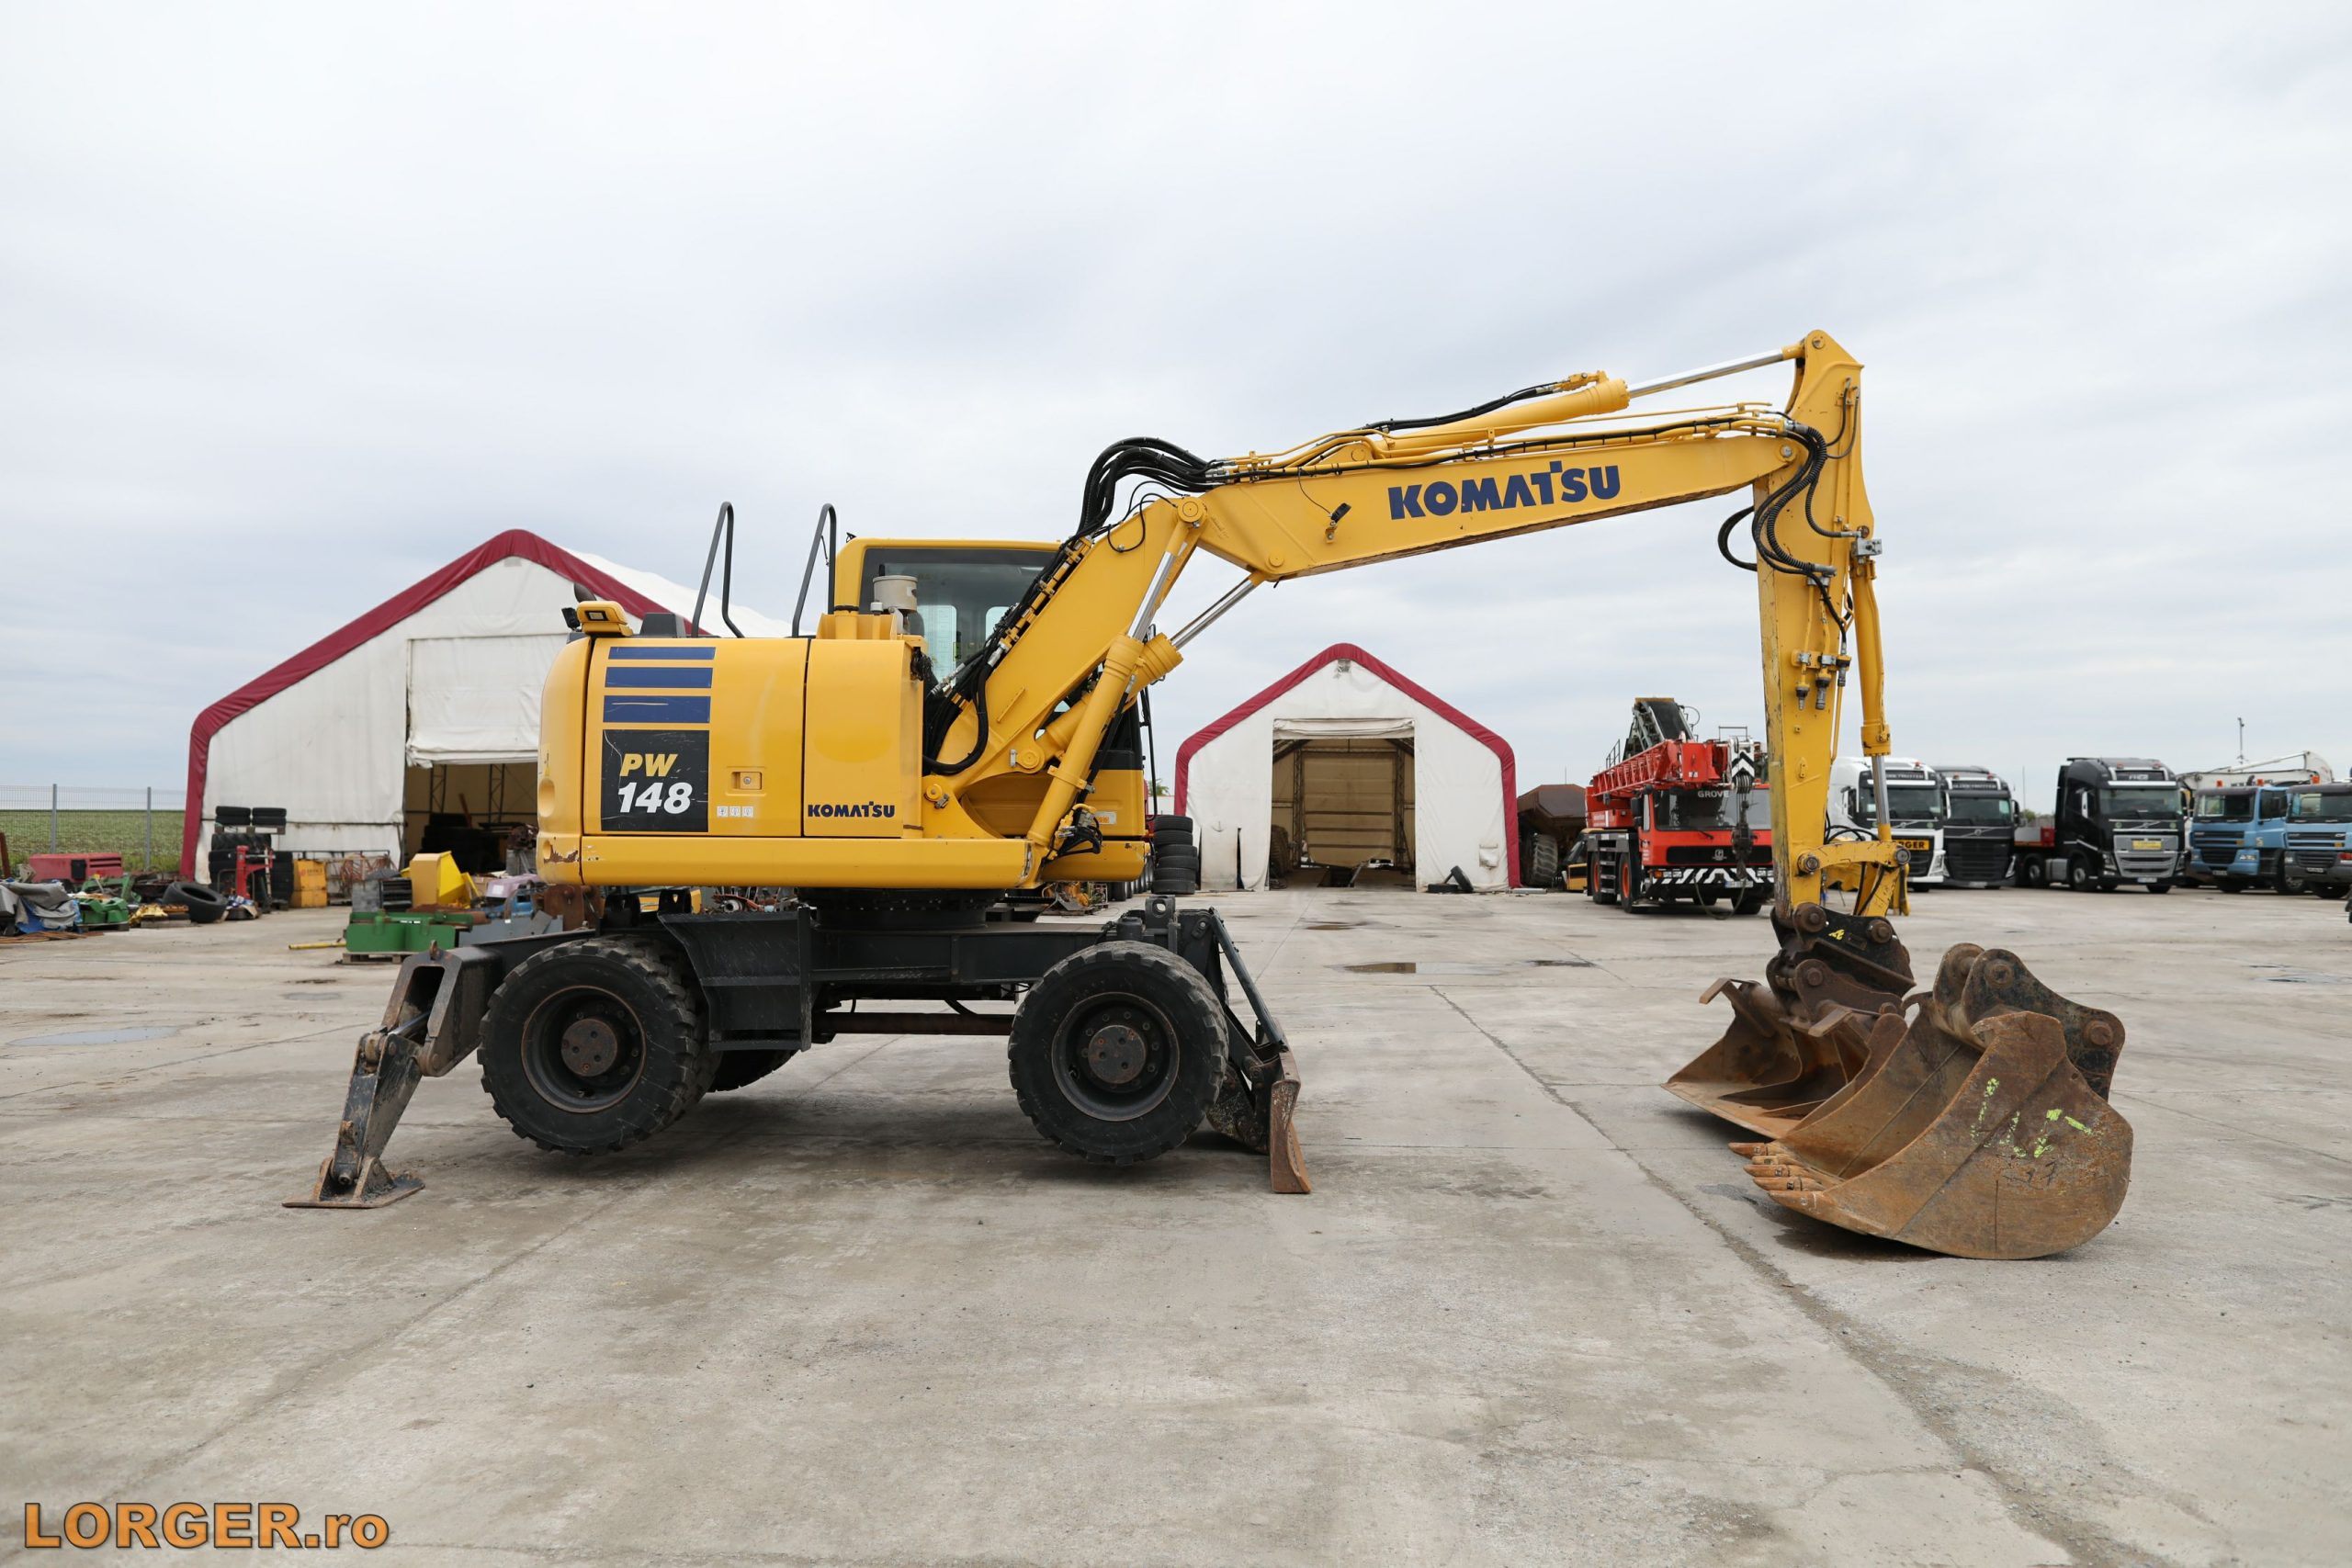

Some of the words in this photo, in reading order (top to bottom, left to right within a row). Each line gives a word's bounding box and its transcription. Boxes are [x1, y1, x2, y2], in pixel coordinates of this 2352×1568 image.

[1387, 460, 1621, 520] KOMATSU
[619, 753, 678, 777] PW
[617, 782, 693, 814] 148
[1697, 790, 1730, 798] GROVE
[808, 801, 895, 818] KOMATSU
